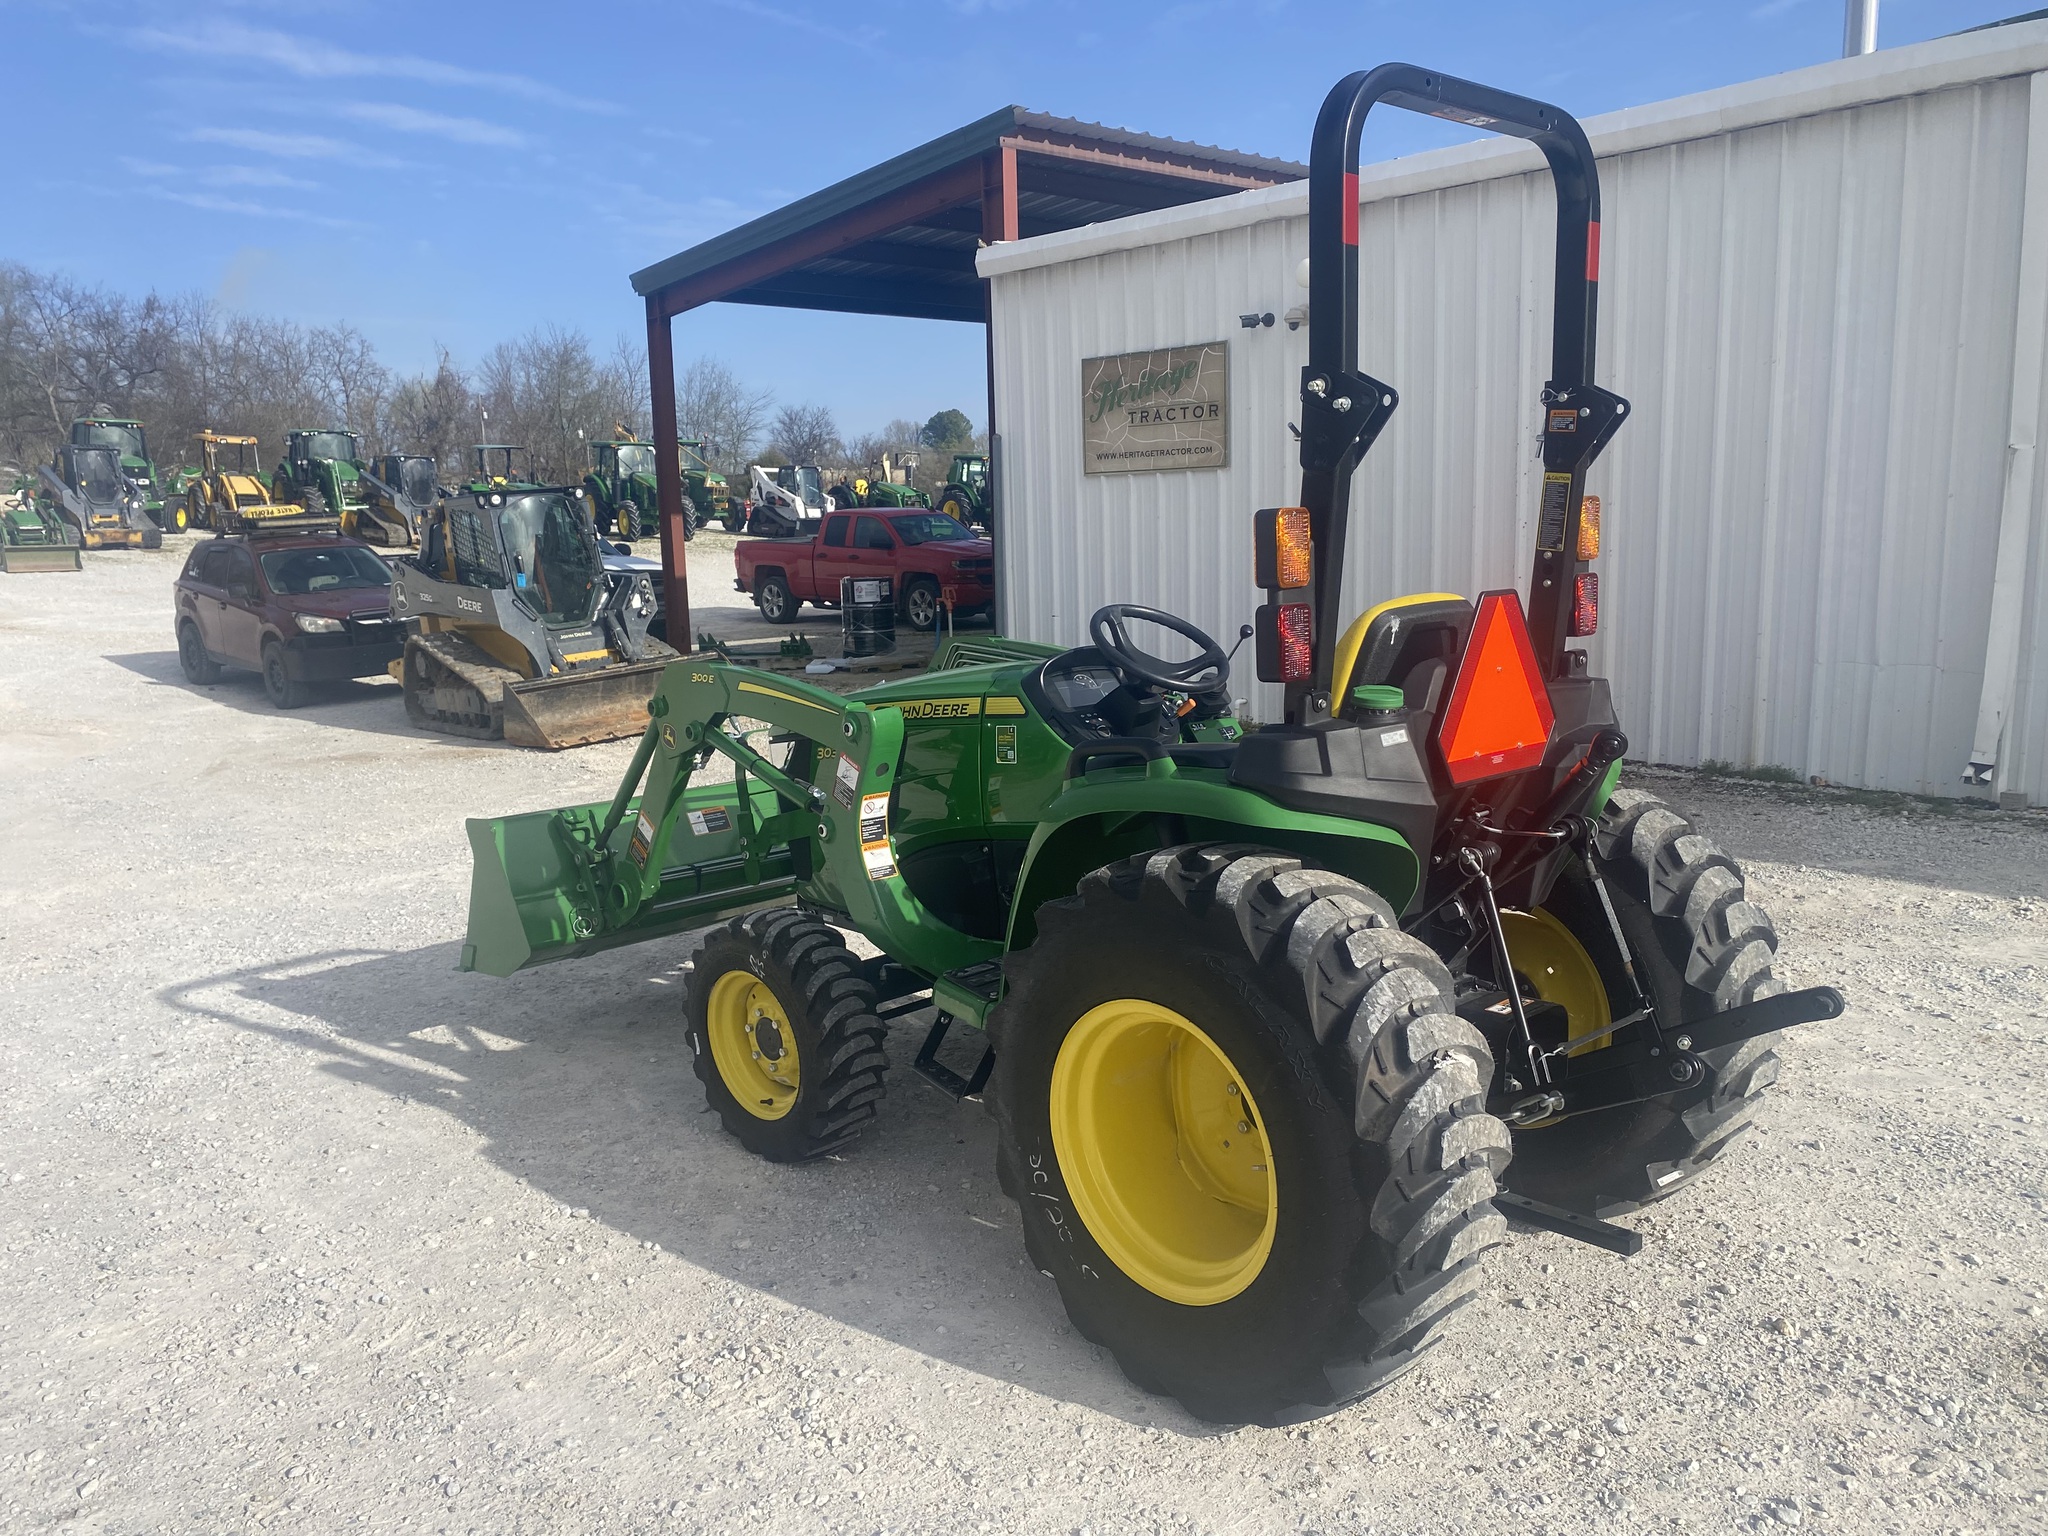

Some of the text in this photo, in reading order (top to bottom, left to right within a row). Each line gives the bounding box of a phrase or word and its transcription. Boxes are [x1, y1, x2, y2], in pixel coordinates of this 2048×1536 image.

[1089, 360, 1198, 423] Heritage
[1128, 404, 1219, 424] TRACTOR
[1096, 446, 1213, 461] WWW.HERITAGETRACTOR.COM
[457, 596, 483, 613] DEERE
[922, 703, 970, 717] DEERE
[868, 792, 889, 800] WARNING
